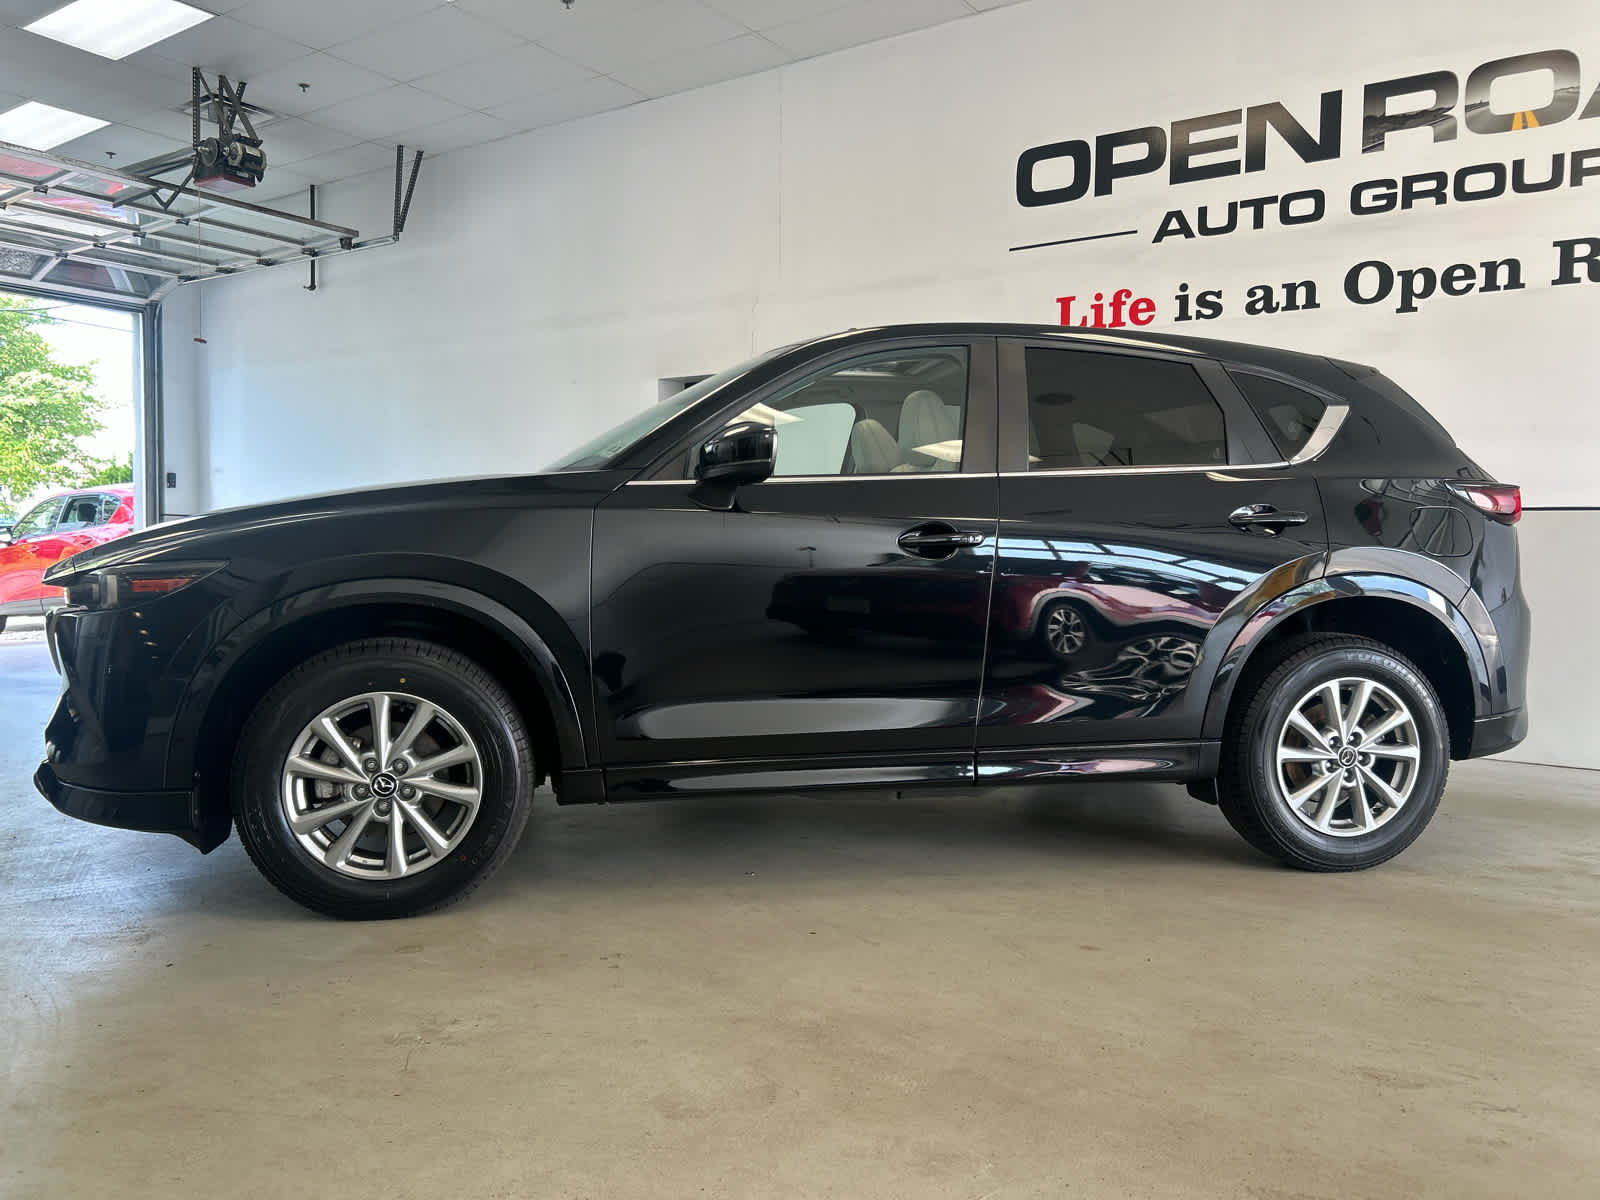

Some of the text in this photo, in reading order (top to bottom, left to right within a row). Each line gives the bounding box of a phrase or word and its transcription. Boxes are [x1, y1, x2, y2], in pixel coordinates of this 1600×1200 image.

[1016, 49, 1600, 207] OPEN RO
[1152, 189, 1326, 243] AUTO
[1056, 288, 1156, 329] Life
[1174, 282, 1223, 322] is
[1245, 279, 1320, 316] an
[1343, 256, 1526, 314] Open
